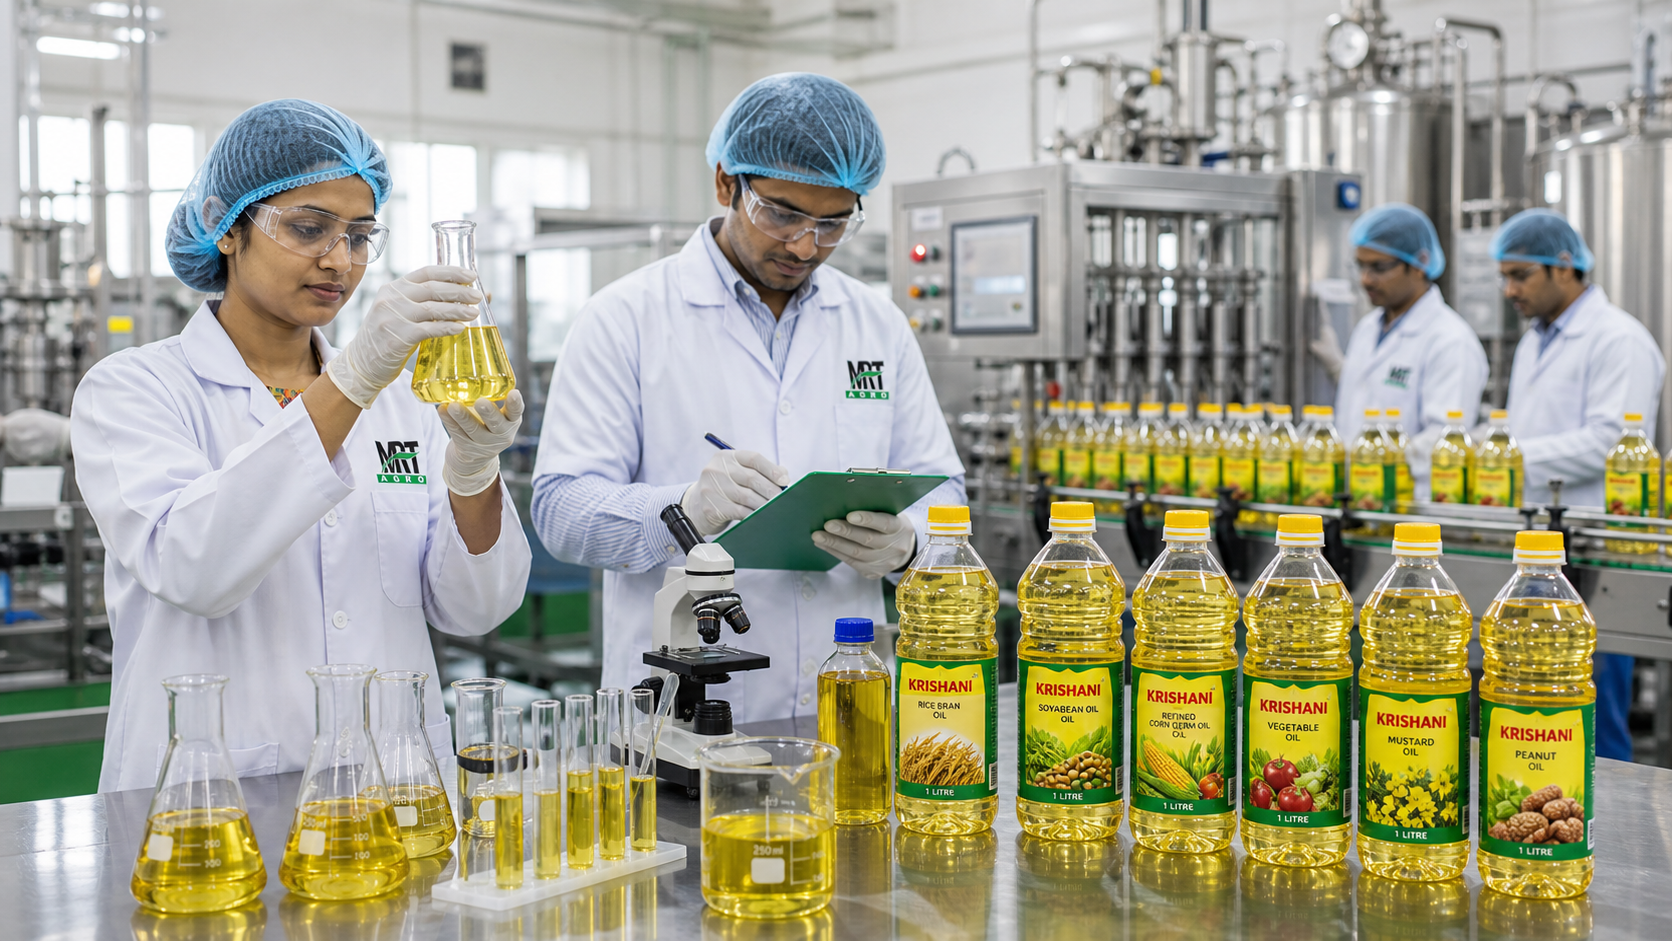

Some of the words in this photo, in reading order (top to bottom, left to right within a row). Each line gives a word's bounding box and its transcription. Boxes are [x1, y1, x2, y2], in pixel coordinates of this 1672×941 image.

[846, 359, 885, 390] MRT
[374, 440, 420, 474] MRT
[908, 678, 973, 693] KRISHANI
[1036, 682, 1101, 697] KRISHANI
[1147, 689, 1213, 705] KRISHANI
[918, 701, 936, 710] RICE
[937, 702, 961, 710] BRAN
[1038, 704, 1084, 714] SOYABEAN
[1085, 704, 1099, 713] OIL
[1260, 698, 1328, 715] KRISHANI
[933, 711, 947, 720] OIL
[1060, 715, 1075, 724] OIL
[1376, 711, 1447, 729] KRISHANI
[1149, 719, 1170, 728] CORN
[1197, 722, 1211, 730] OIL
[1267, 721, 1320, 733] VEGETABLE
[1285, 733, 1301, 742] OIL
[1500, 725, 1573, 742] KRISHANI
[1388, 736, 1435, 747] MUSTARD
[1402, 747, 1419, 757] OIL
[1515, 750, 1557, 761] PEANUT
[1528, 762, 1545, 771] OIL
[925, 788, 929, 796] 1
[932, 788, 955, 796] LITRE
[1053, 792, 1057, 800] 1
[1059, 792, 1084, 801] LITRE
[1163, 802, 1167, 810] 1
[1169, 803, 1194, 811] LITRE
[1277, 814, 1281, 822] 1
[1284, 815, 1309, 823] LITRE
[1395, 830, 1399, 838] 1
[1402, 831, 1428, 840] LITRE
[1519, 846, 1523, 854] 1
[1526, 847, 1554, 856] LITRE
